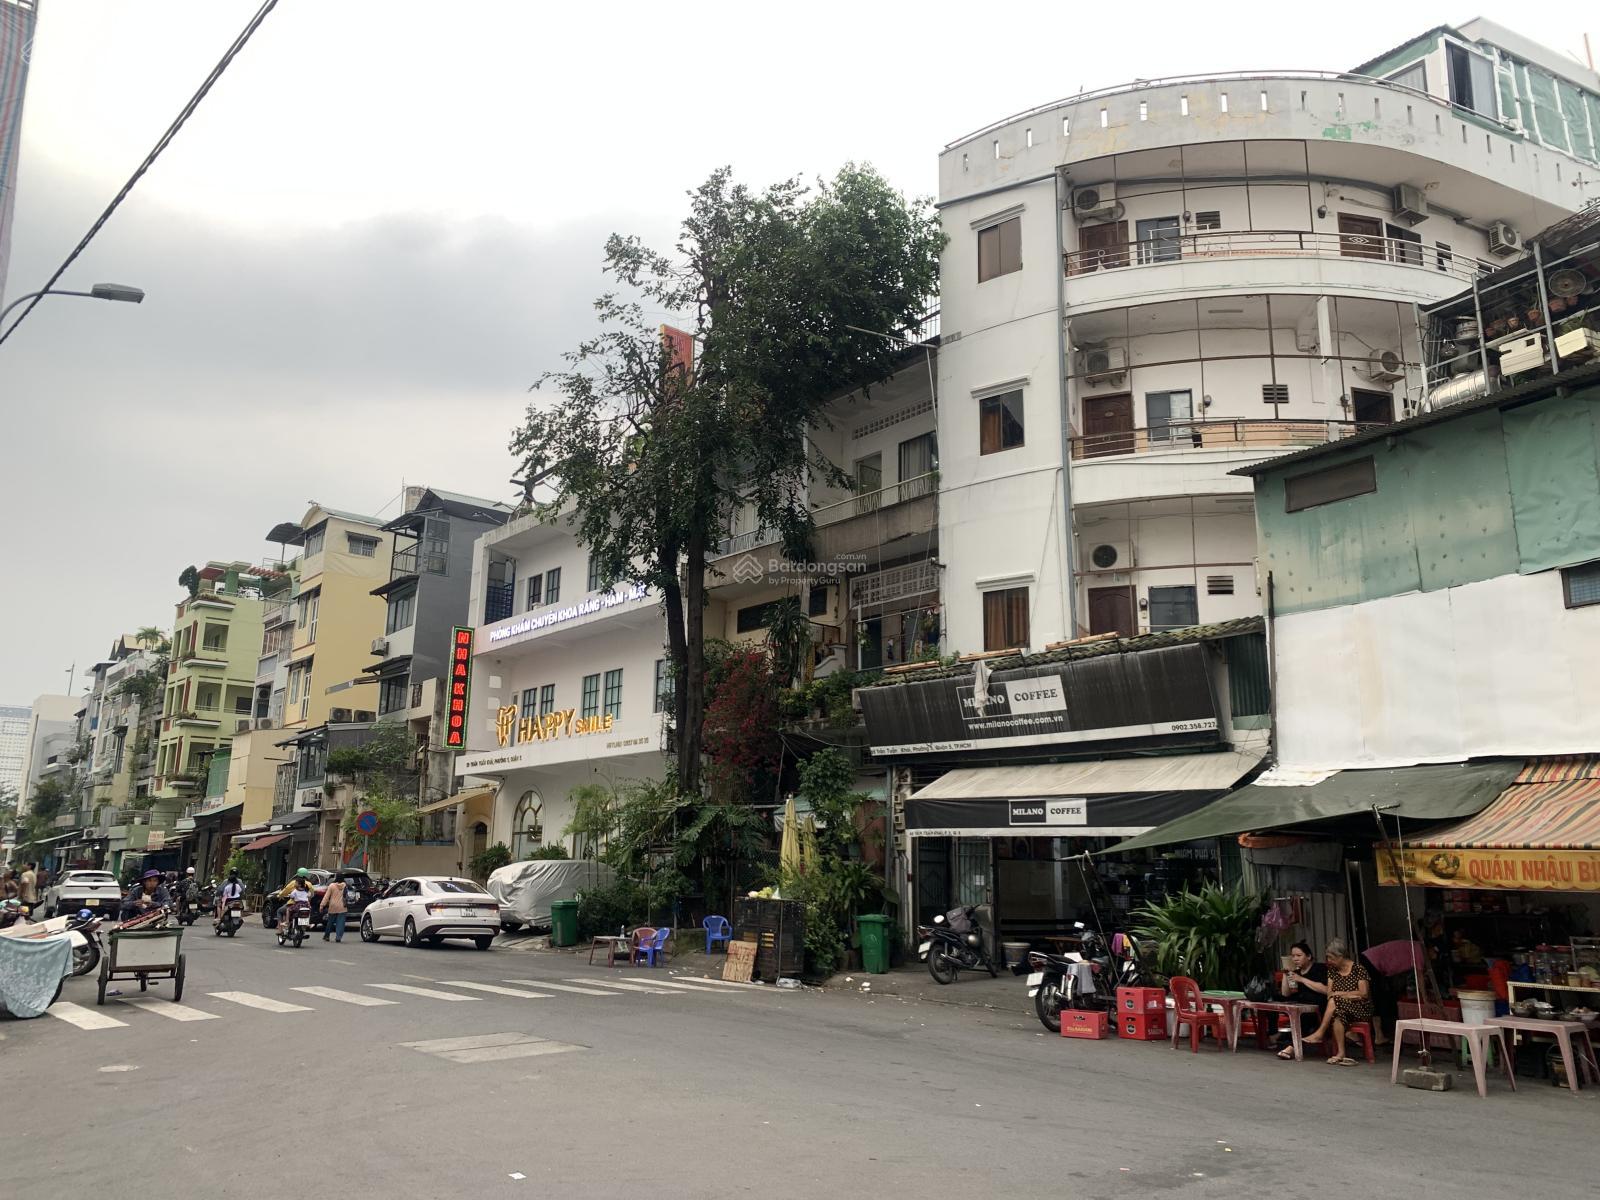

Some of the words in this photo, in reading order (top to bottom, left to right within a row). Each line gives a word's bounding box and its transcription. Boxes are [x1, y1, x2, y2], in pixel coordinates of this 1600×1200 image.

[558, 605, 578, 621] KHOA
[1014, 688, 1058, 702] COFFEE
[518, 708, 576, 744] HAPPY
[575, 713, 613, 734] SMILE
[968, 714, 1064, 730] www.milanocoffee.com.vn
[1012, 808, 1044, 816] MILANO
[1468, 854, 1516, 883] QUÁN
[1521, 854, 1573, 886] NHẬU
[1578, 856, 1600, 882] BÌ
